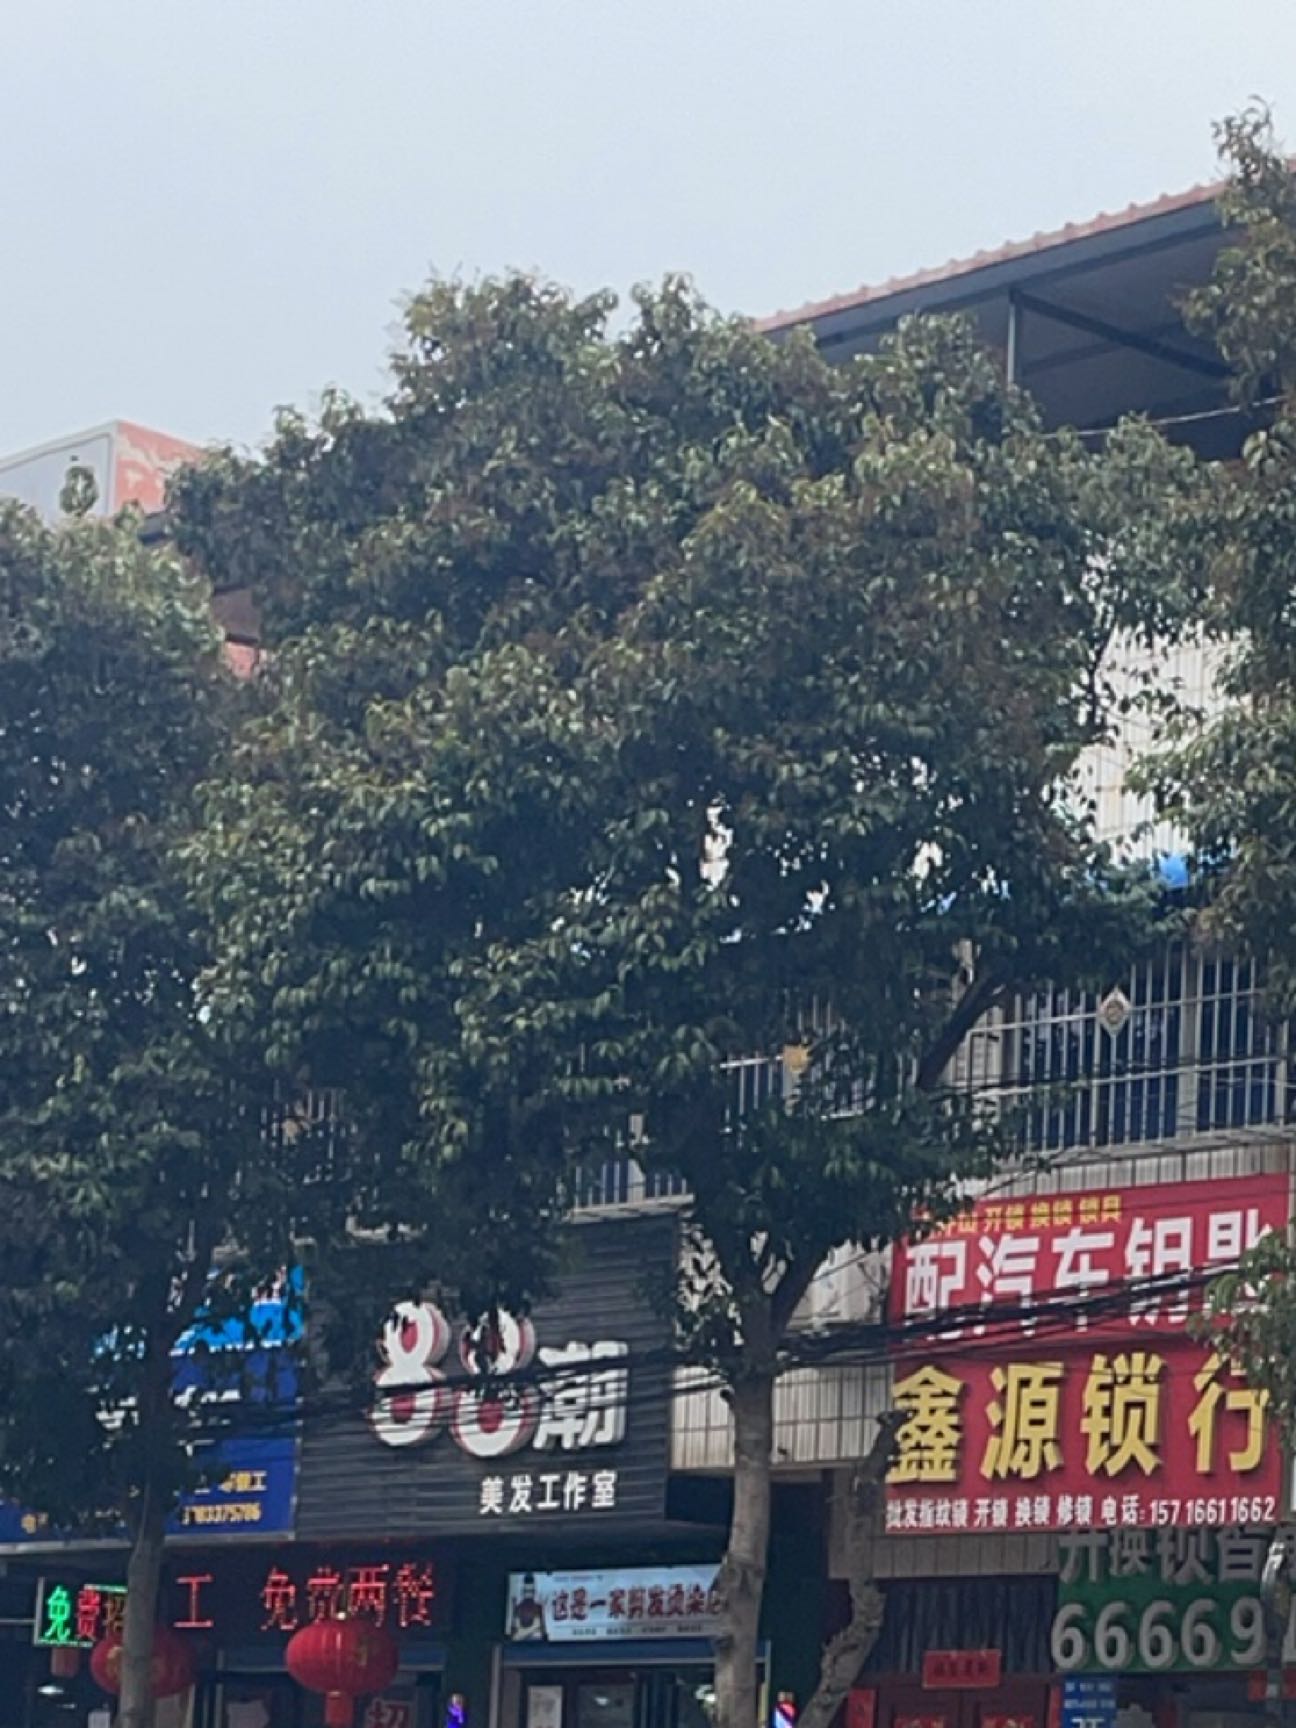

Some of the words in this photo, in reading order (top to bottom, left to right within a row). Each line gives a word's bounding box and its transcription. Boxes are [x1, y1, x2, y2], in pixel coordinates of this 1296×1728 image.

[886, 1350, 1270, 1485] 鑫源锁行
[480, 1470, 617, 1515] 美发工作室
